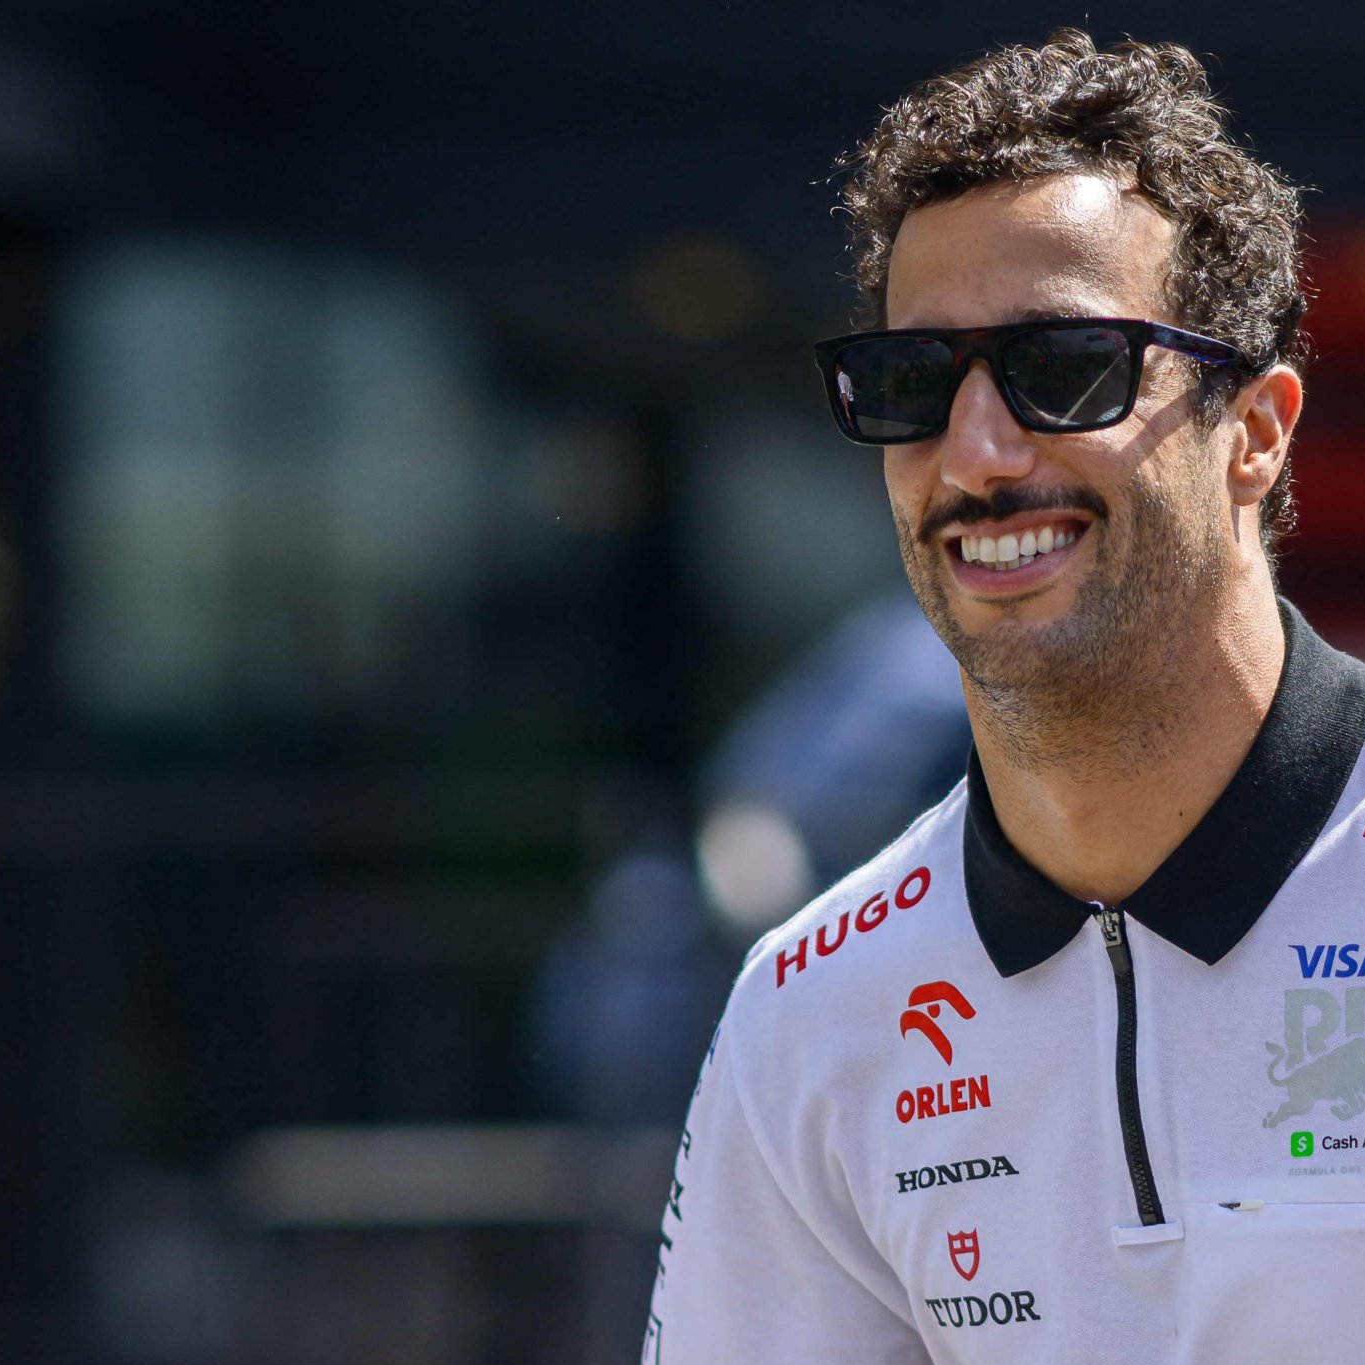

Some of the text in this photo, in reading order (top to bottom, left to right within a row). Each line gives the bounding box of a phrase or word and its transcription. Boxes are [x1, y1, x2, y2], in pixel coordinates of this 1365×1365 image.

[776, 866, 931, 989] HUGO
[896, 1075, 991, 1124] ORLEN
[1322, 1135, 1358, 1150] Cash
[895, 1155, 1019, 1193] HONDA
[1289, 1167, 1336, 1176] FORMULA
[925, 1290, 1041, 1328] TUDOR
